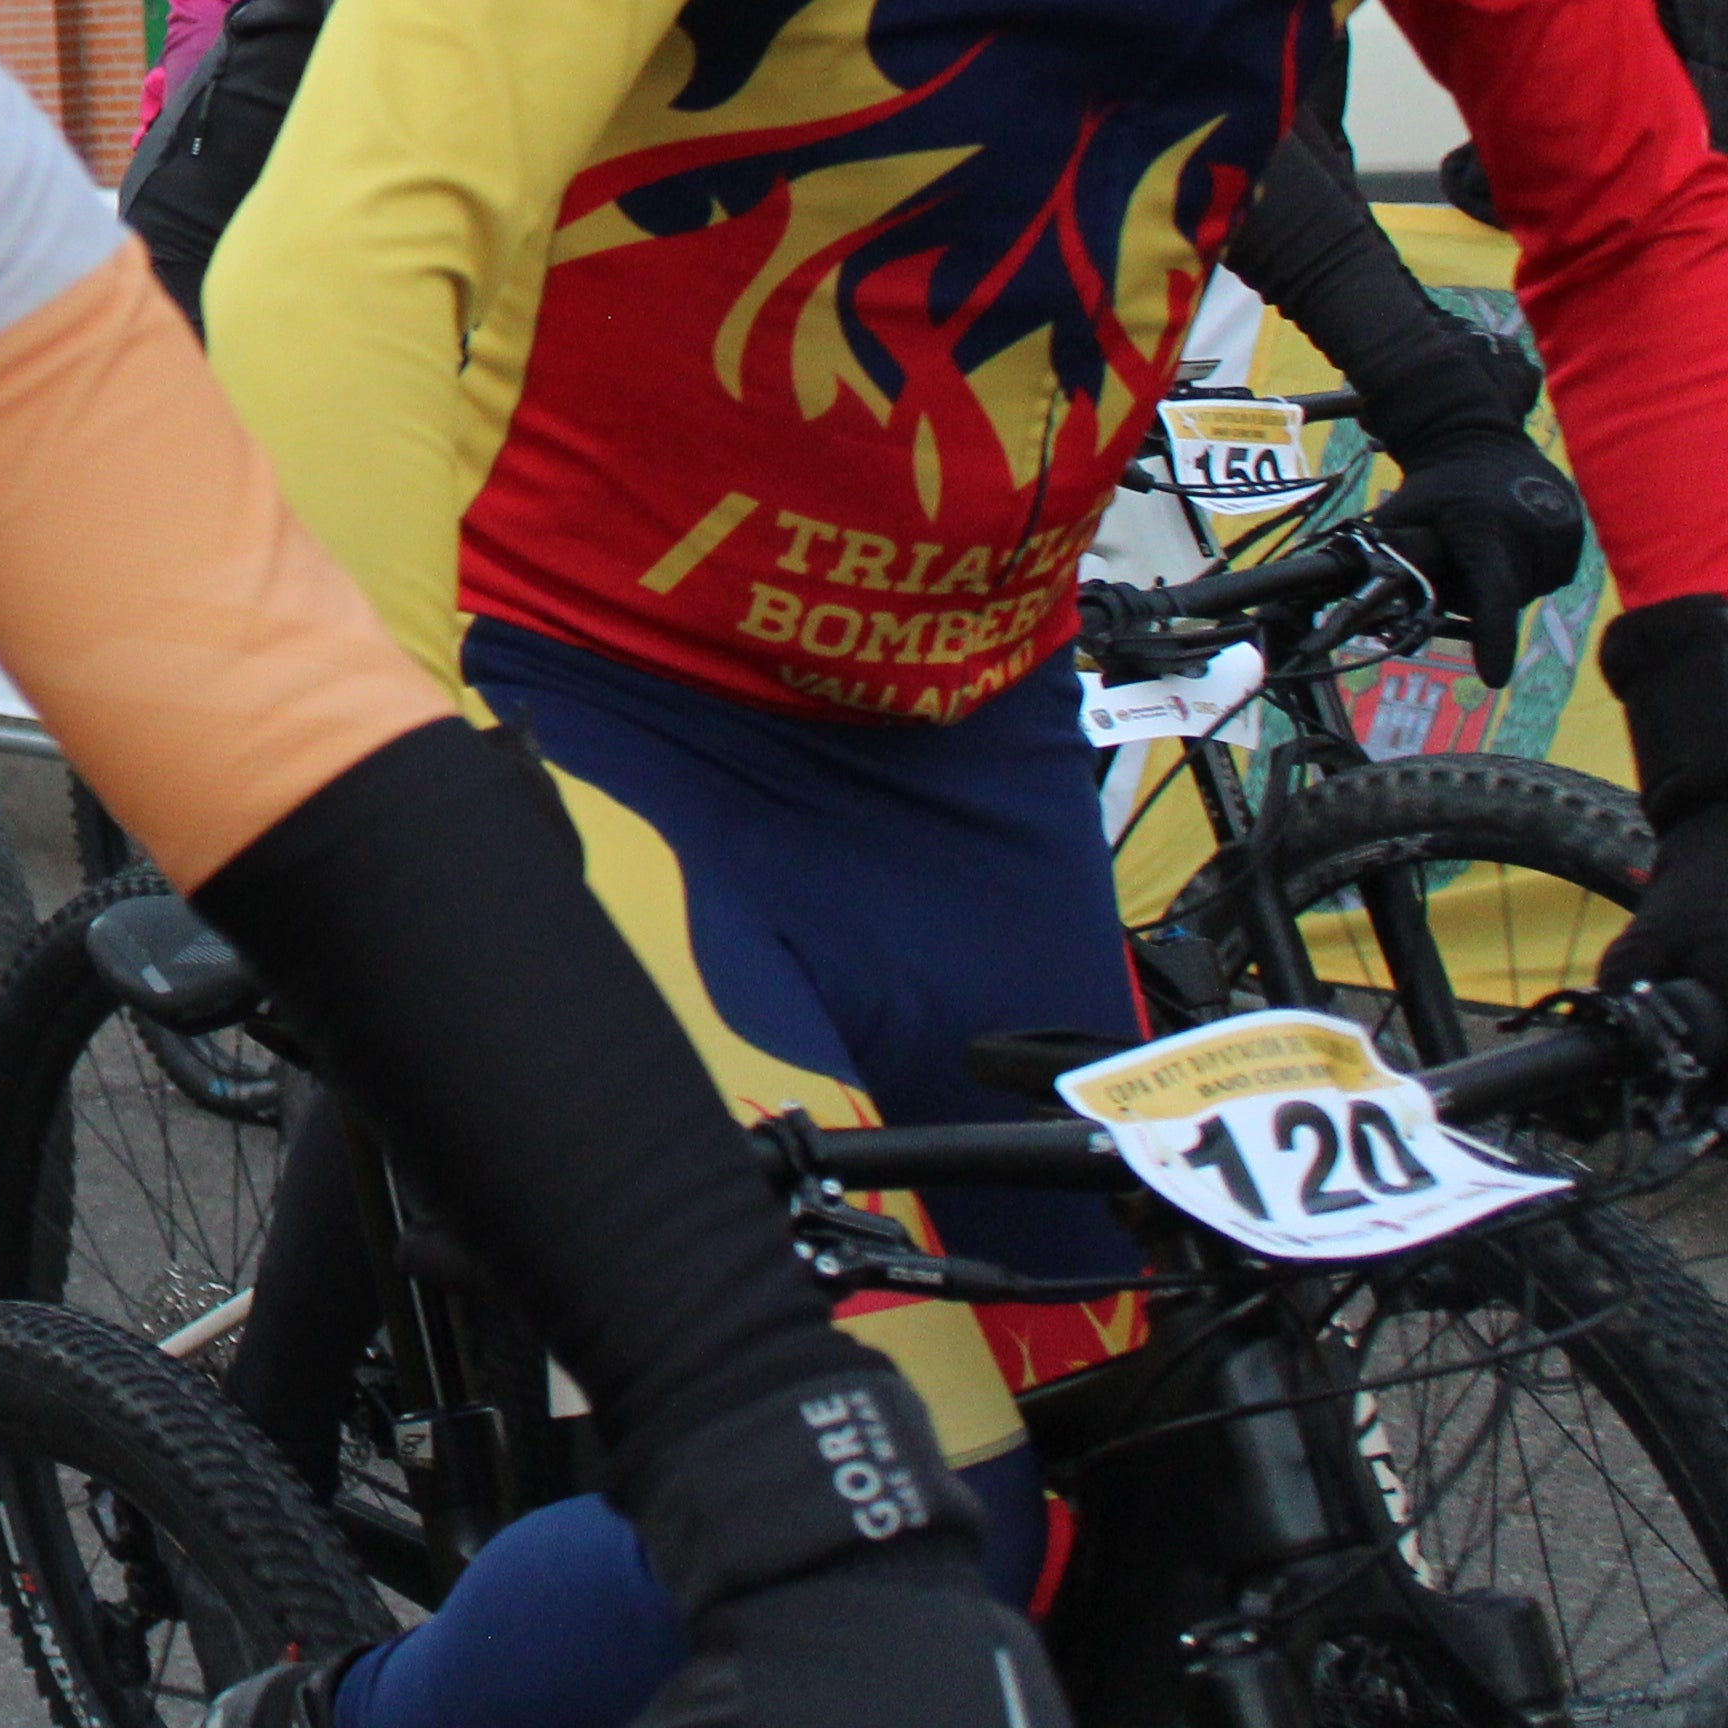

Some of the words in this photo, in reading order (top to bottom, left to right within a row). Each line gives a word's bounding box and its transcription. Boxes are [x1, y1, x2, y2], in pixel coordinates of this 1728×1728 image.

[1194, 446, 1288, 492] 150
[1179, 1099, 1439, 1221] 120
[799, 1392, 902, 1541] GORE
